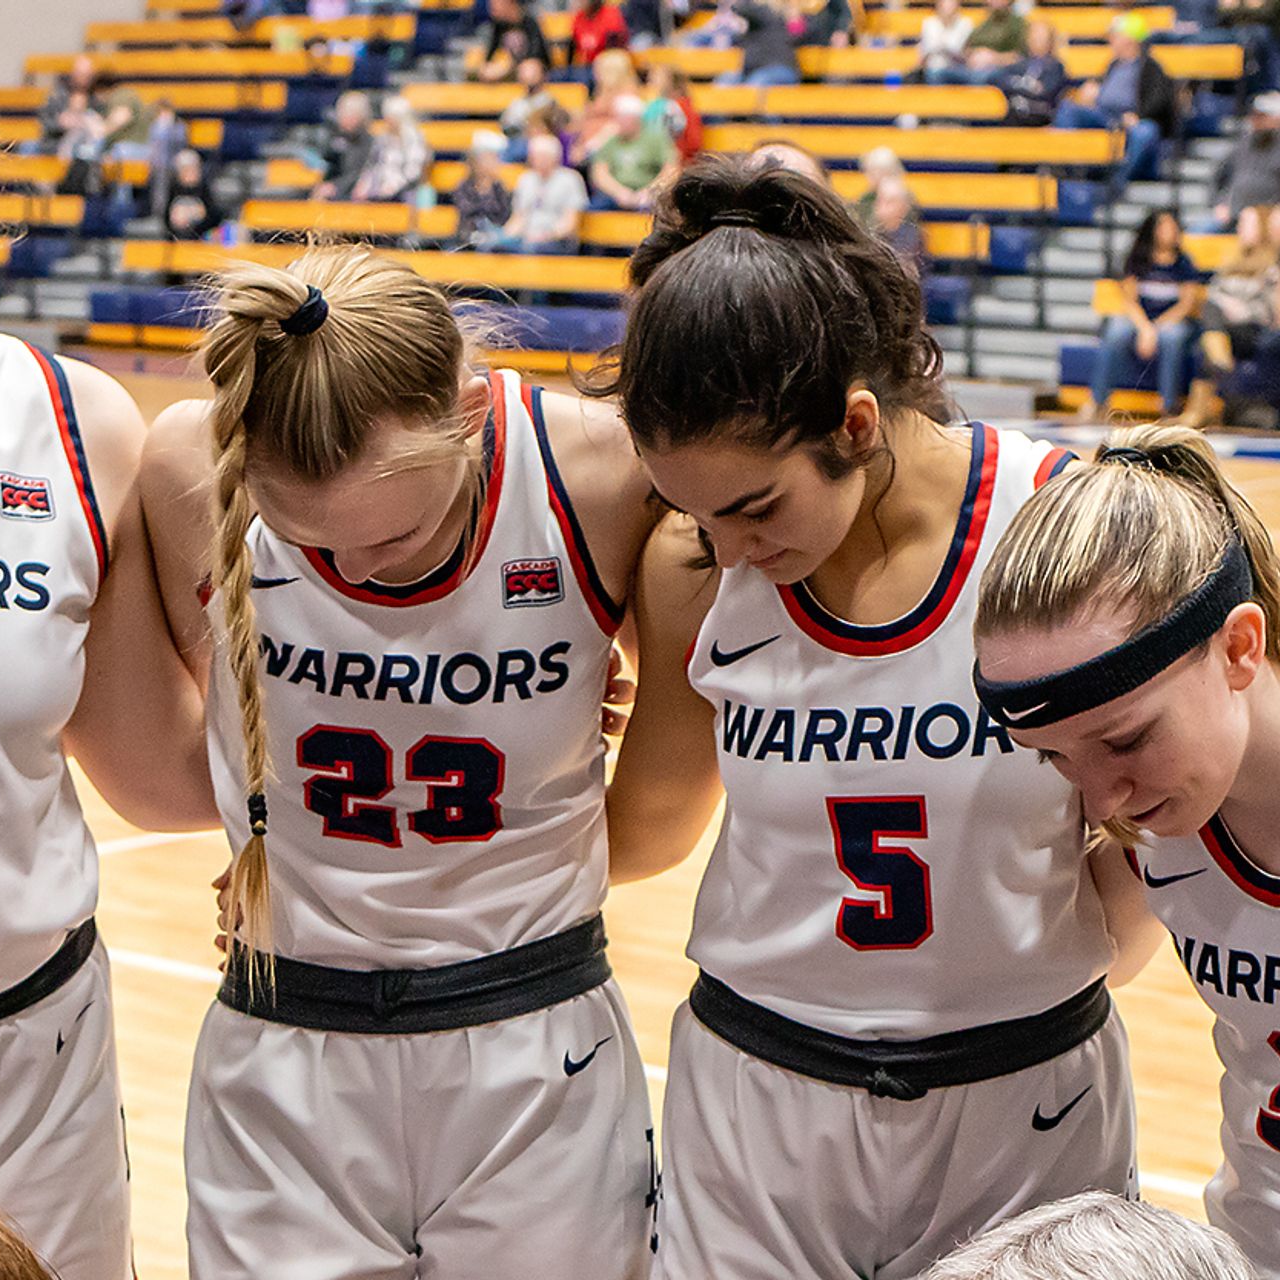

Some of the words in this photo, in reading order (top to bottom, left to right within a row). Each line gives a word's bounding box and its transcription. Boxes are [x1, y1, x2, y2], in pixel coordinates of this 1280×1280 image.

[259, 634, 573, 704] WARRIORS
[722, 699, 1015, 763] WARRIOR
[296, 723, 504, 848] 23
[824, 794, 935, 952] 5
